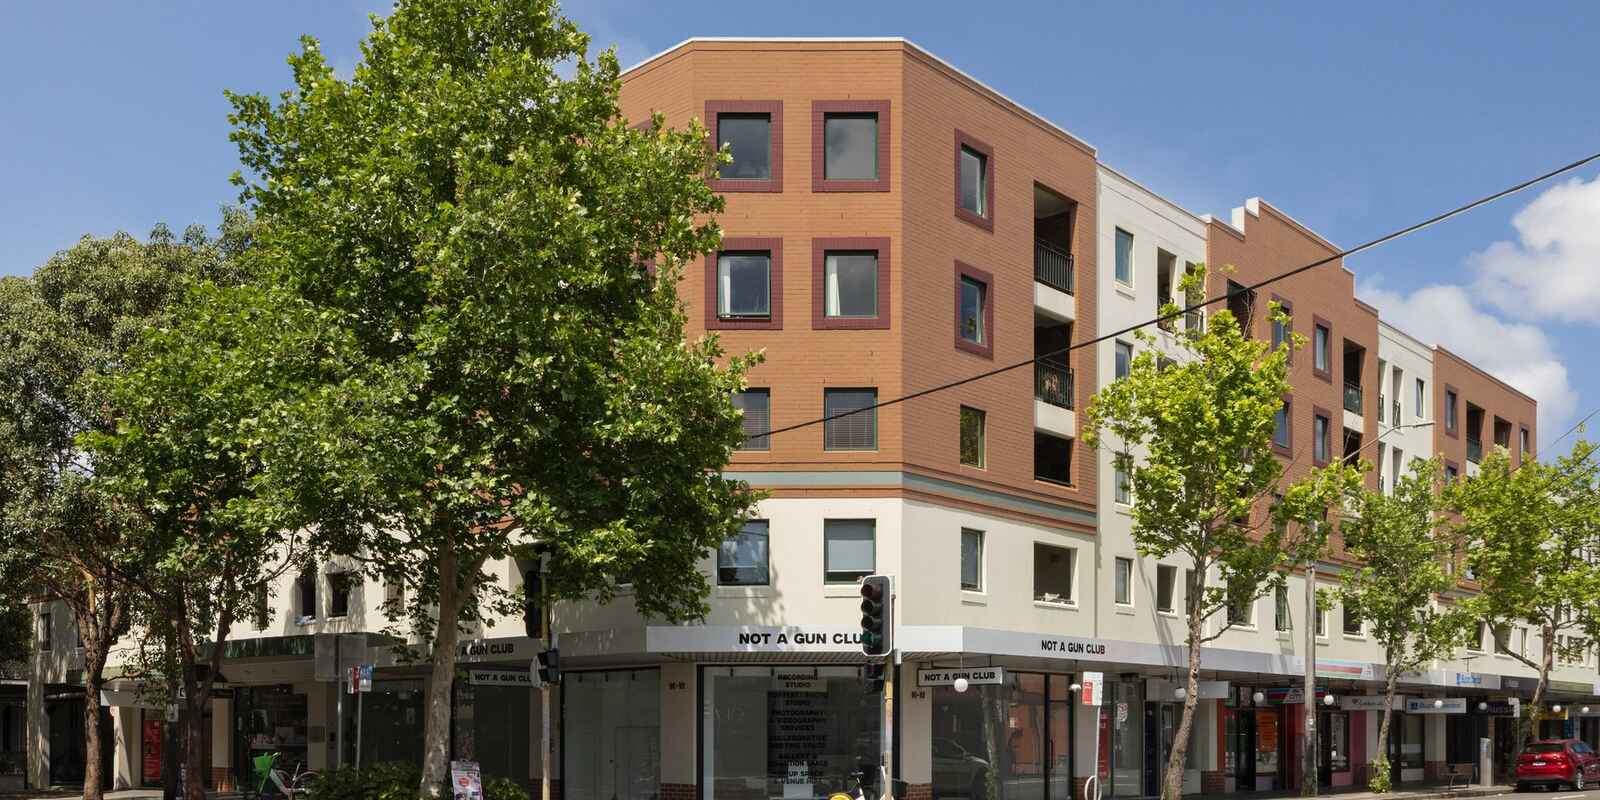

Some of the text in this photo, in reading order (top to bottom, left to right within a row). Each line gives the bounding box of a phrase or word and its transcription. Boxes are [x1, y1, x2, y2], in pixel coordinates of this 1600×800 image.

[739, 633, 863, 645] NOT A GUN CLU
[461, 647, 467, 656] A
[470, 645, 488, 656] GUN
[491, 643, 514, 655] CLUB
[1041, 640, 1106, 655] NOT A GUN CLUB
[501, 674, 516, 682] GUN
[925, 671, 996, 681] NOT A GUN CLUB
